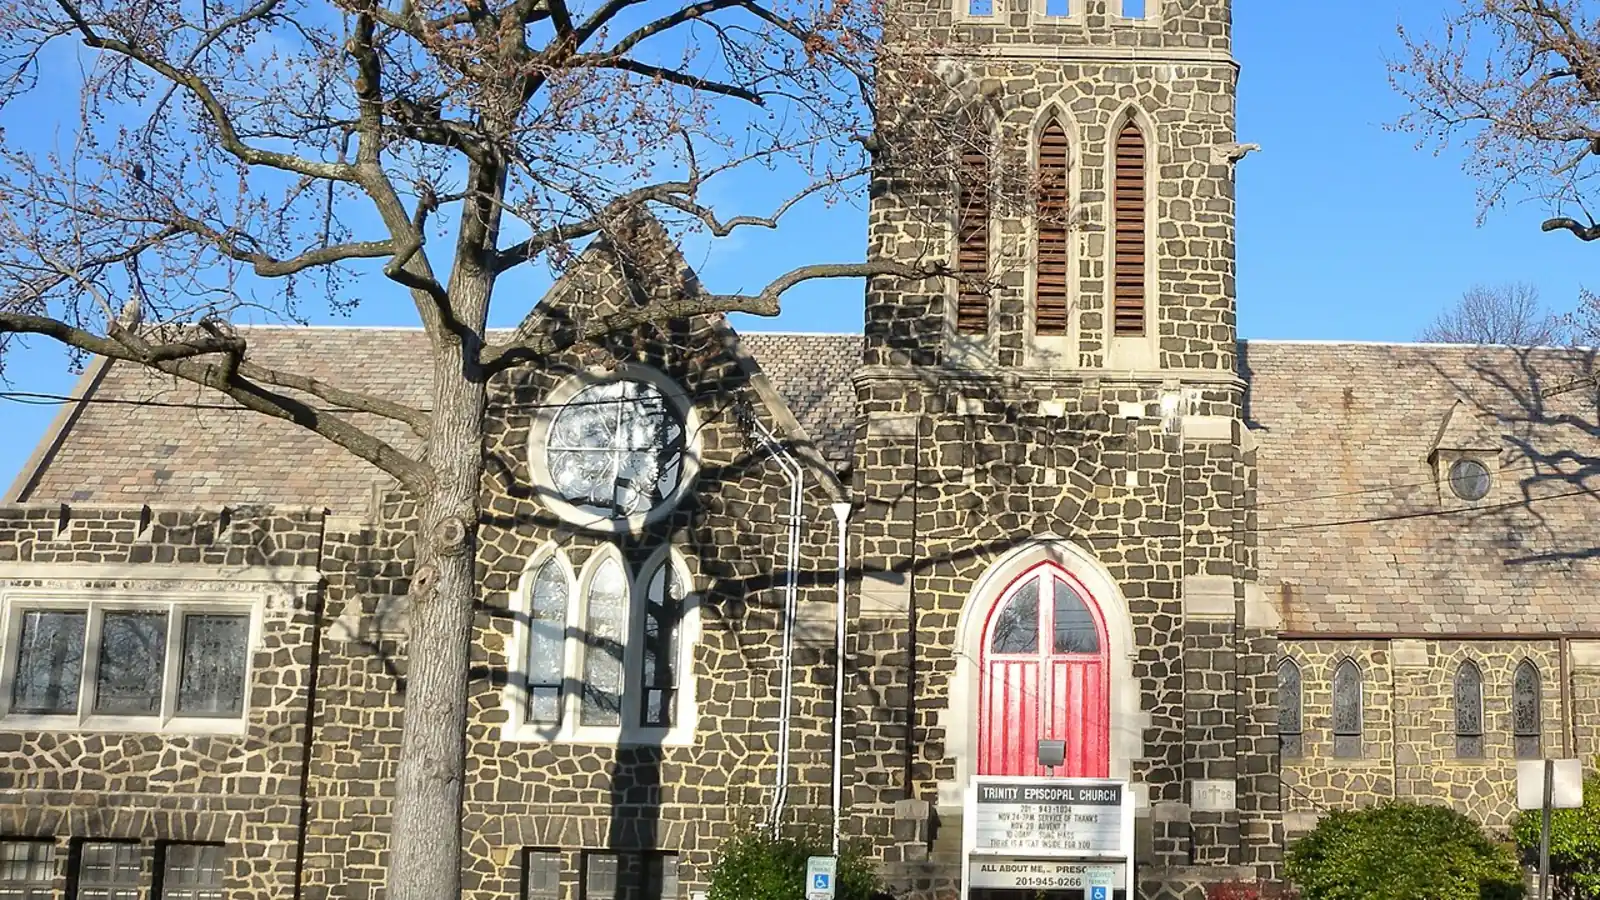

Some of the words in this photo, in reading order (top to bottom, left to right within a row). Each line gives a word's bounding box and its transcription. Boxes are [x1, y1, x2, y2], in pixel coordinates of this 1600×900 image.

[983, 787, 1019, 800] TRINITY
[1024, 788, 1075, 801] EPISCOPAL
[1079, 789, 1116, 802] CHURCH
[1038, 813, 1062, 822] SERVICE
[1063, 814, 1071, 822] OF
[1074, 814, 1098, 824] THANKS
[1010, 840, 1017, 848] IS
[1064, 840, 1076, 849] FOR
[1078, 840, 1091, 849] YOU
[980, 864, 997, 872] ALL
[999, 864, 1029, 873] ABOUT
[1015, 876, 1082, 887] 201-945-0266
